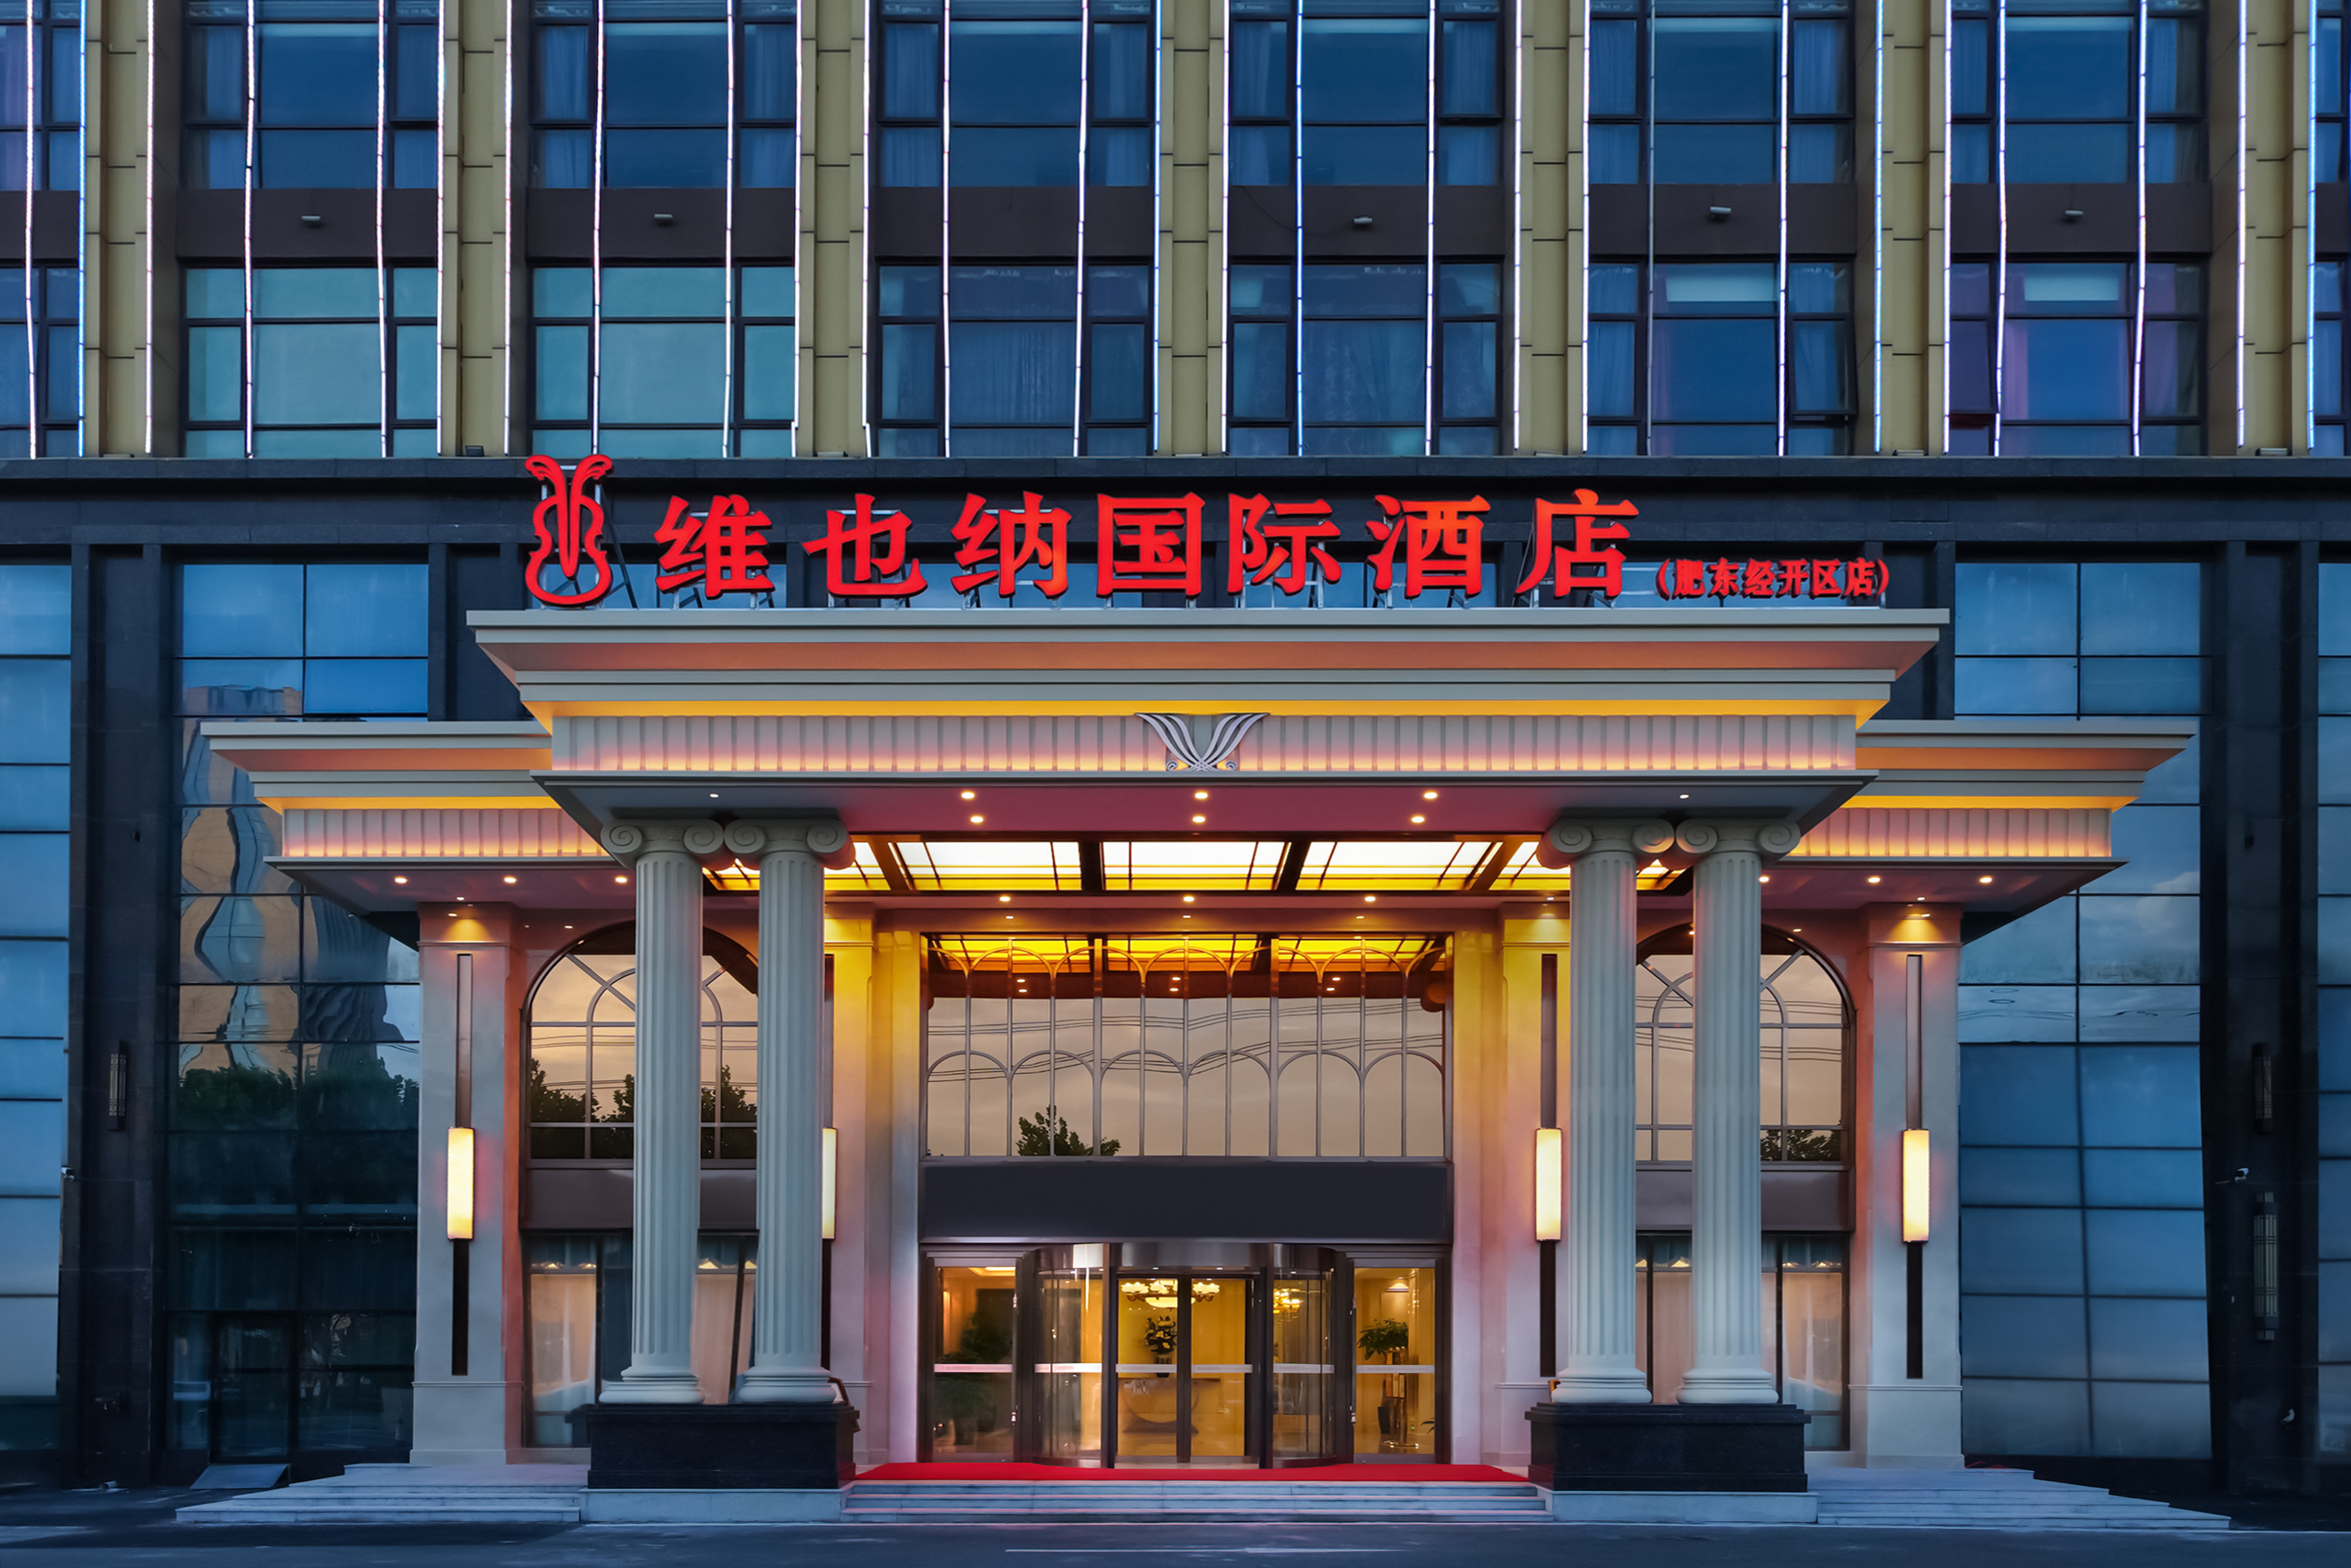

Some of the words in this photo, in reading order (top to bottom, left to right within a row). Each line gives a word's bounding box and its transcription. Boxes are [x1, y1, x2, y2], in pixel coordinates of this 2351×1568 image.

[653, 488, 1640, 598] 维也纳国际酒店
